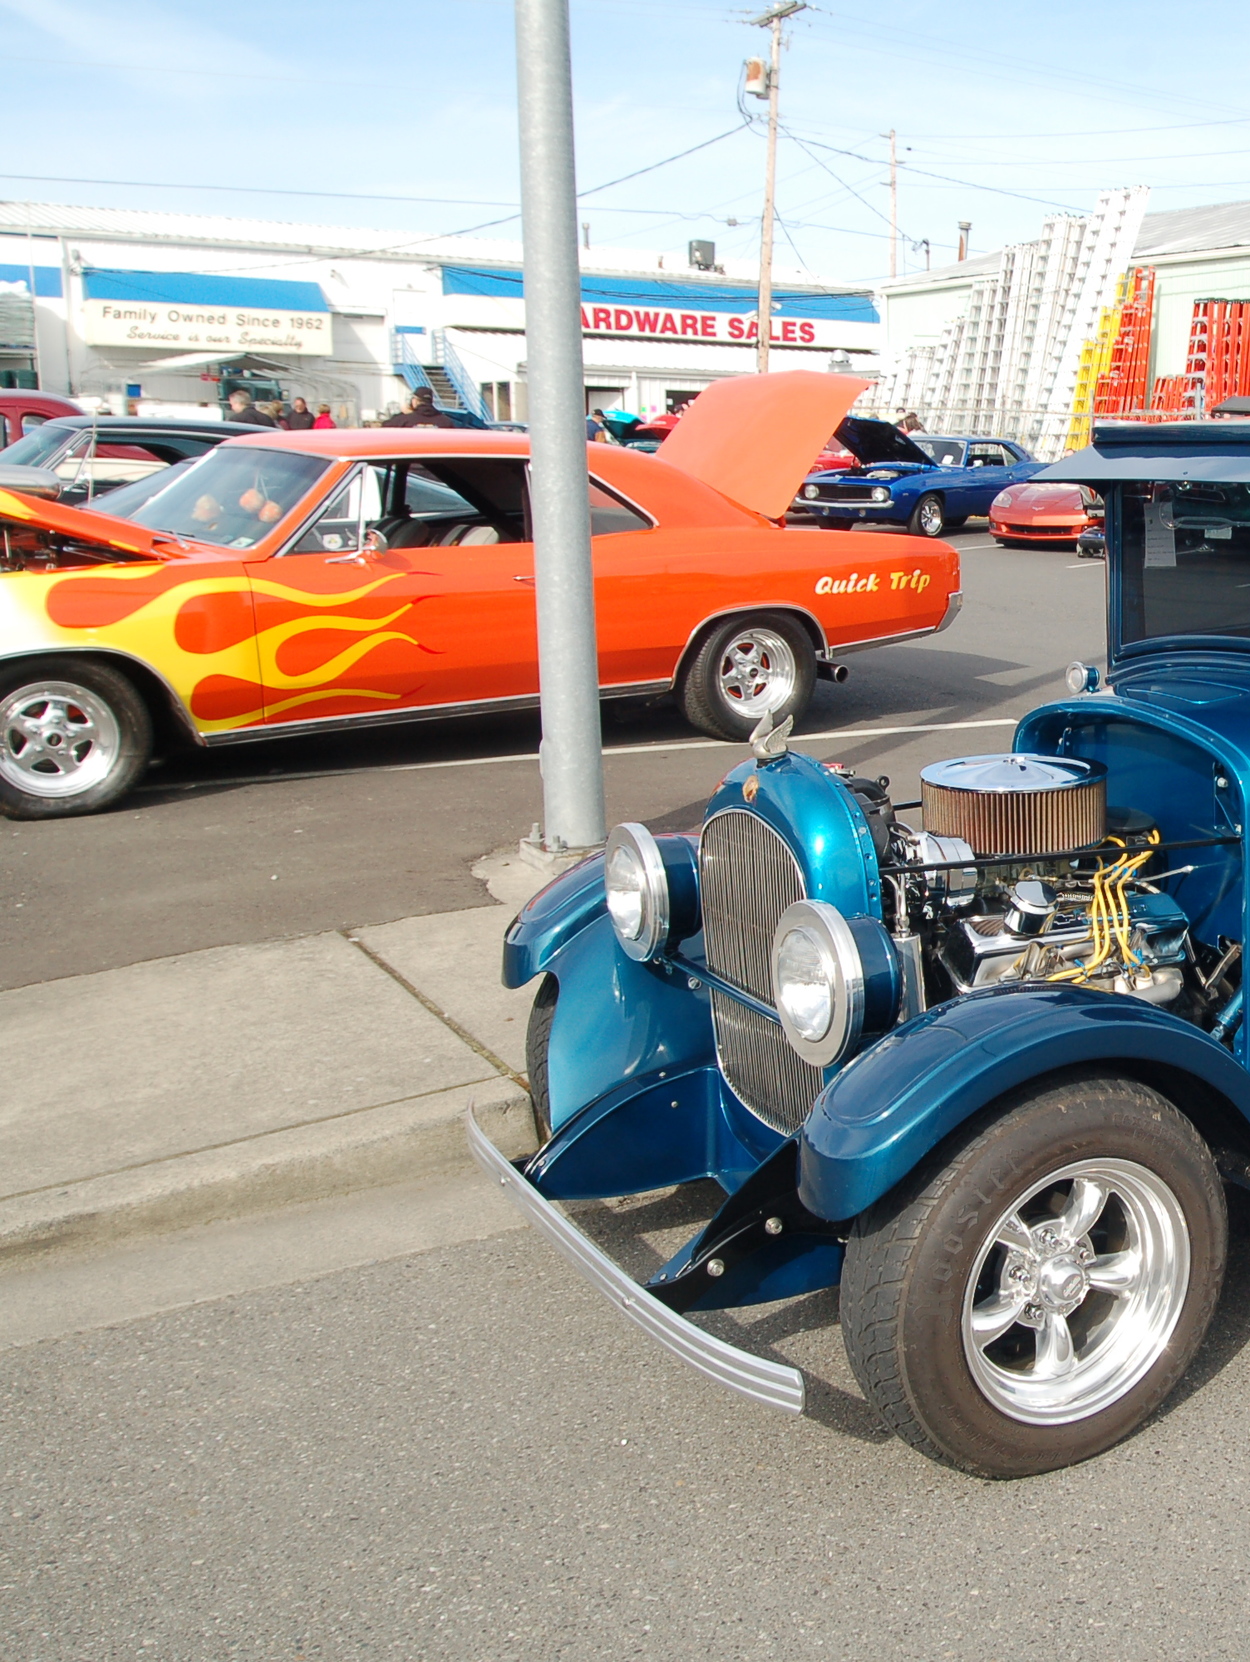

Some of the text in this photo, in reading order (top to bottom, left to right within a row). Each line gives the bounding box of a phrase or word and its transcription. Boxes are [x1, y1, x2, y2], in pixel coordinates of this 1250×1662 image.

[102, 306, 323, 330] Family Owned Since 1962
[727, 317, 815, 343] SALES
[126, 325, 303, 350] Service is our Specialty
[815, 569, 931, 595] Quick Trip
